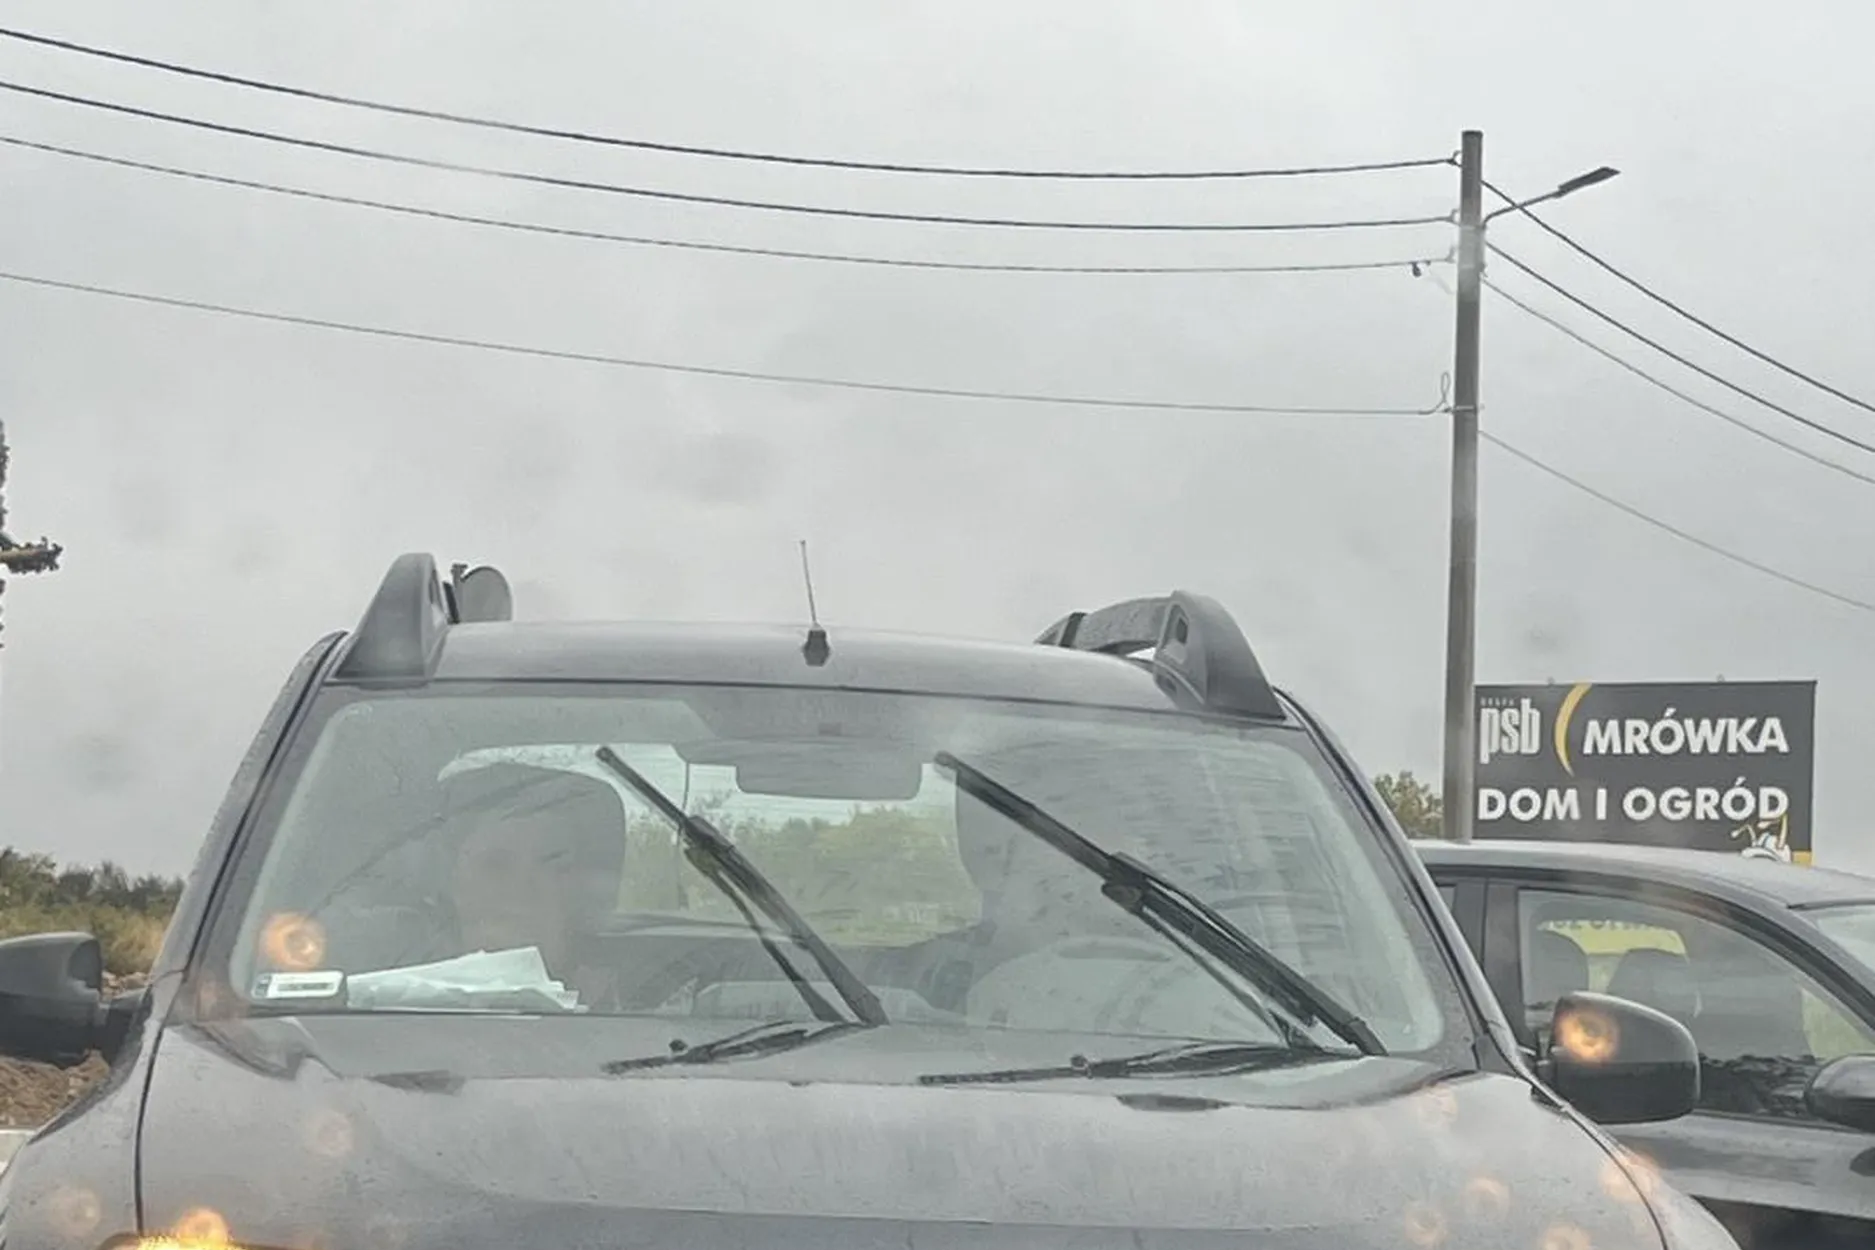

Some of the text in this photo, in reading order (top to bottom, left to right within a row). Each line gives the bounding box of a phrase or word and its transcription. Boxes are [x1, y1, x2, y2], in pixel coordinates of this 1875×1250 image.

[1480, 698, 1541, 764] psb
[1583, 708, 1790, 755] MRÓWKA
[1478, 776, 1788, 822] DOM I OGRÓD
